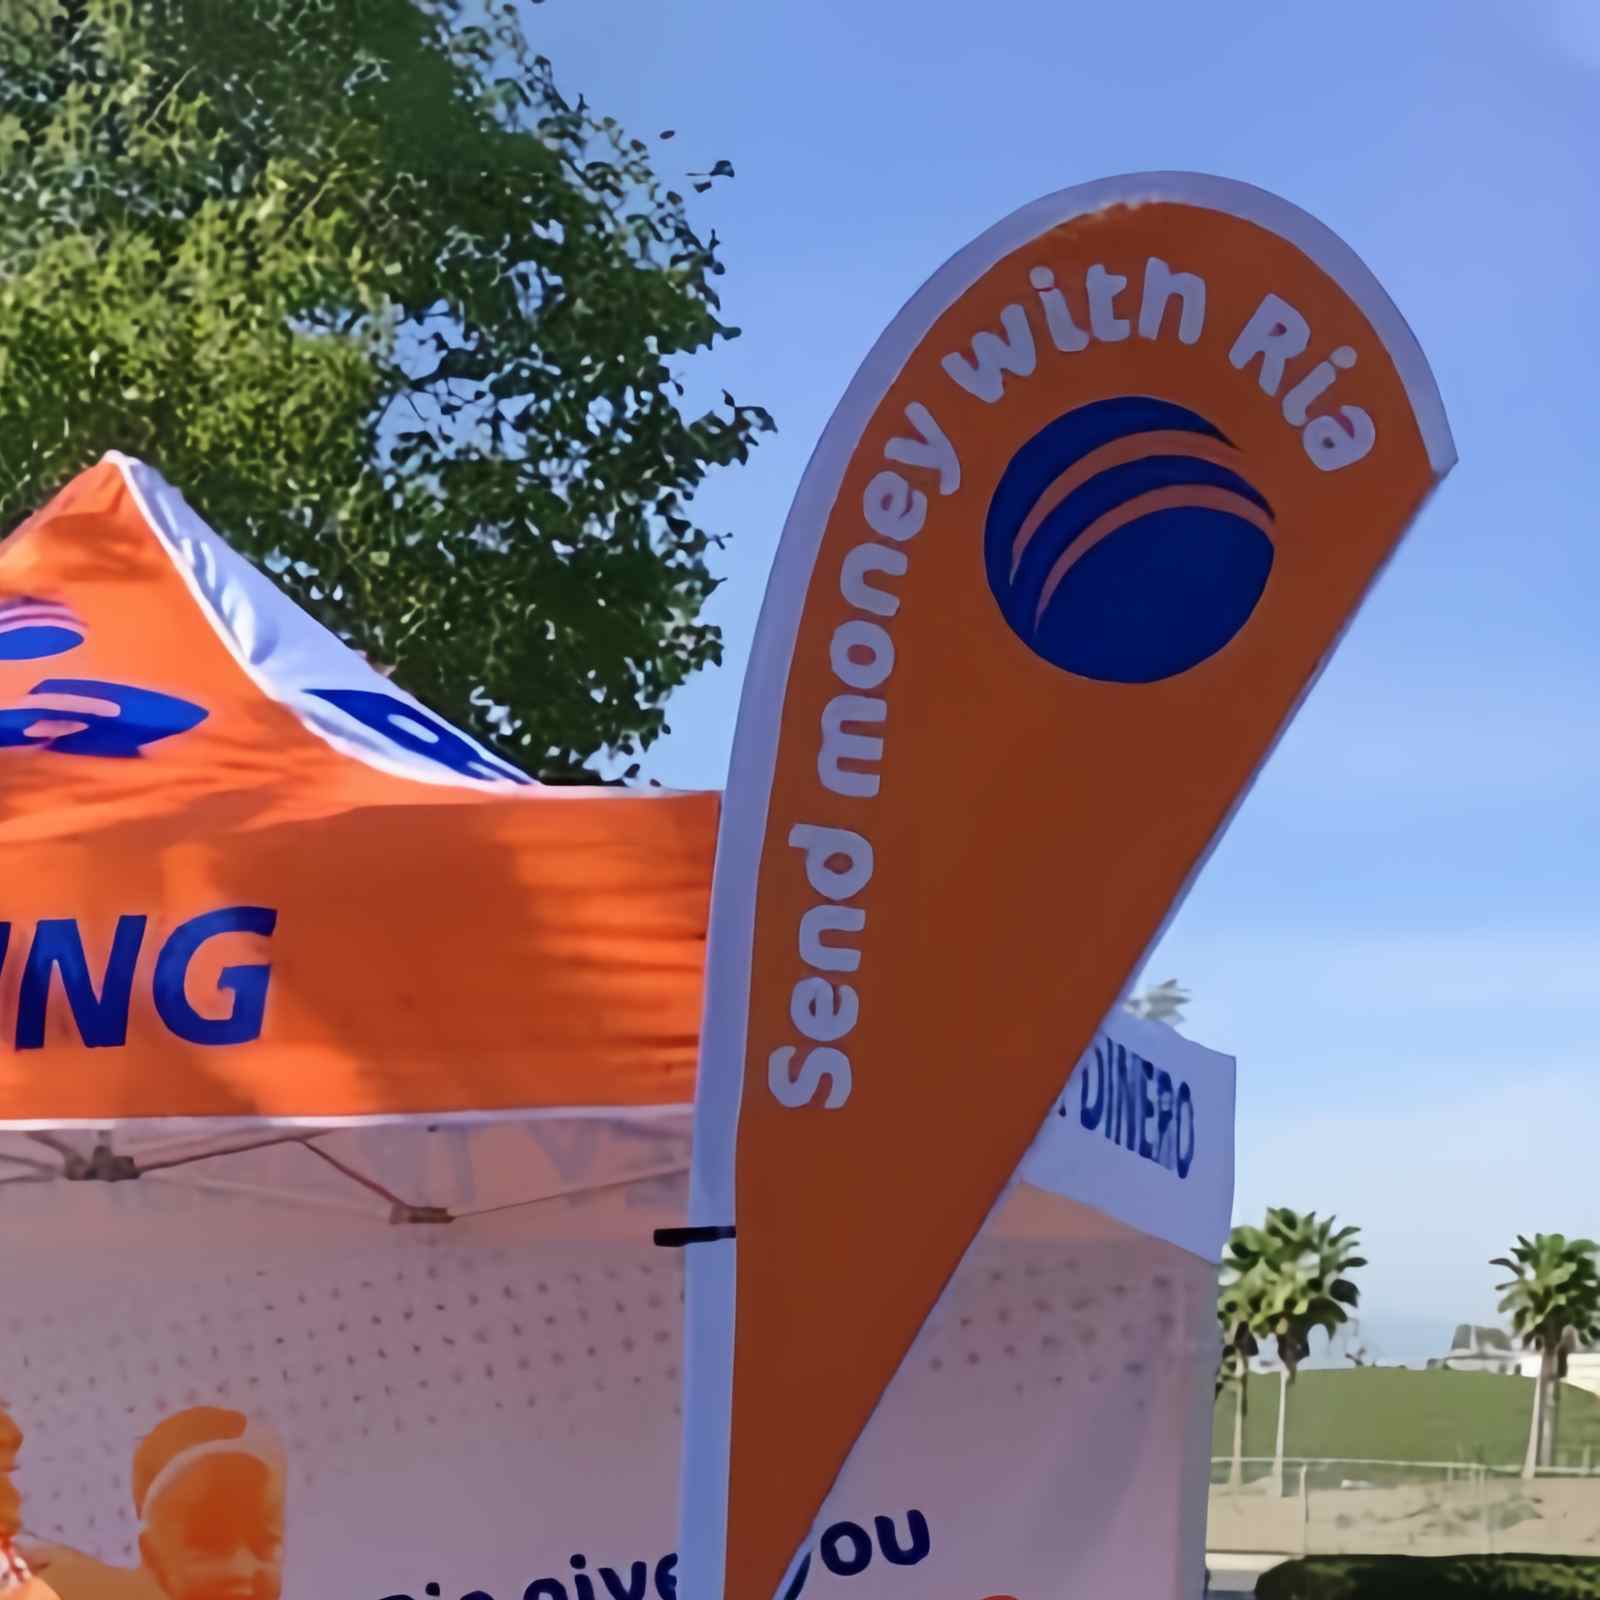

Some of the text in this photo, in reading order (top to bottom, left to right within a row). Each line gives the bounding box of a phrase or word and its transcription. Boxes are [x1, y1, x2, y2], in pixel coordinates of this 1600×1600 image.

[768, 256, 1376, 1110] Send money with Ria
